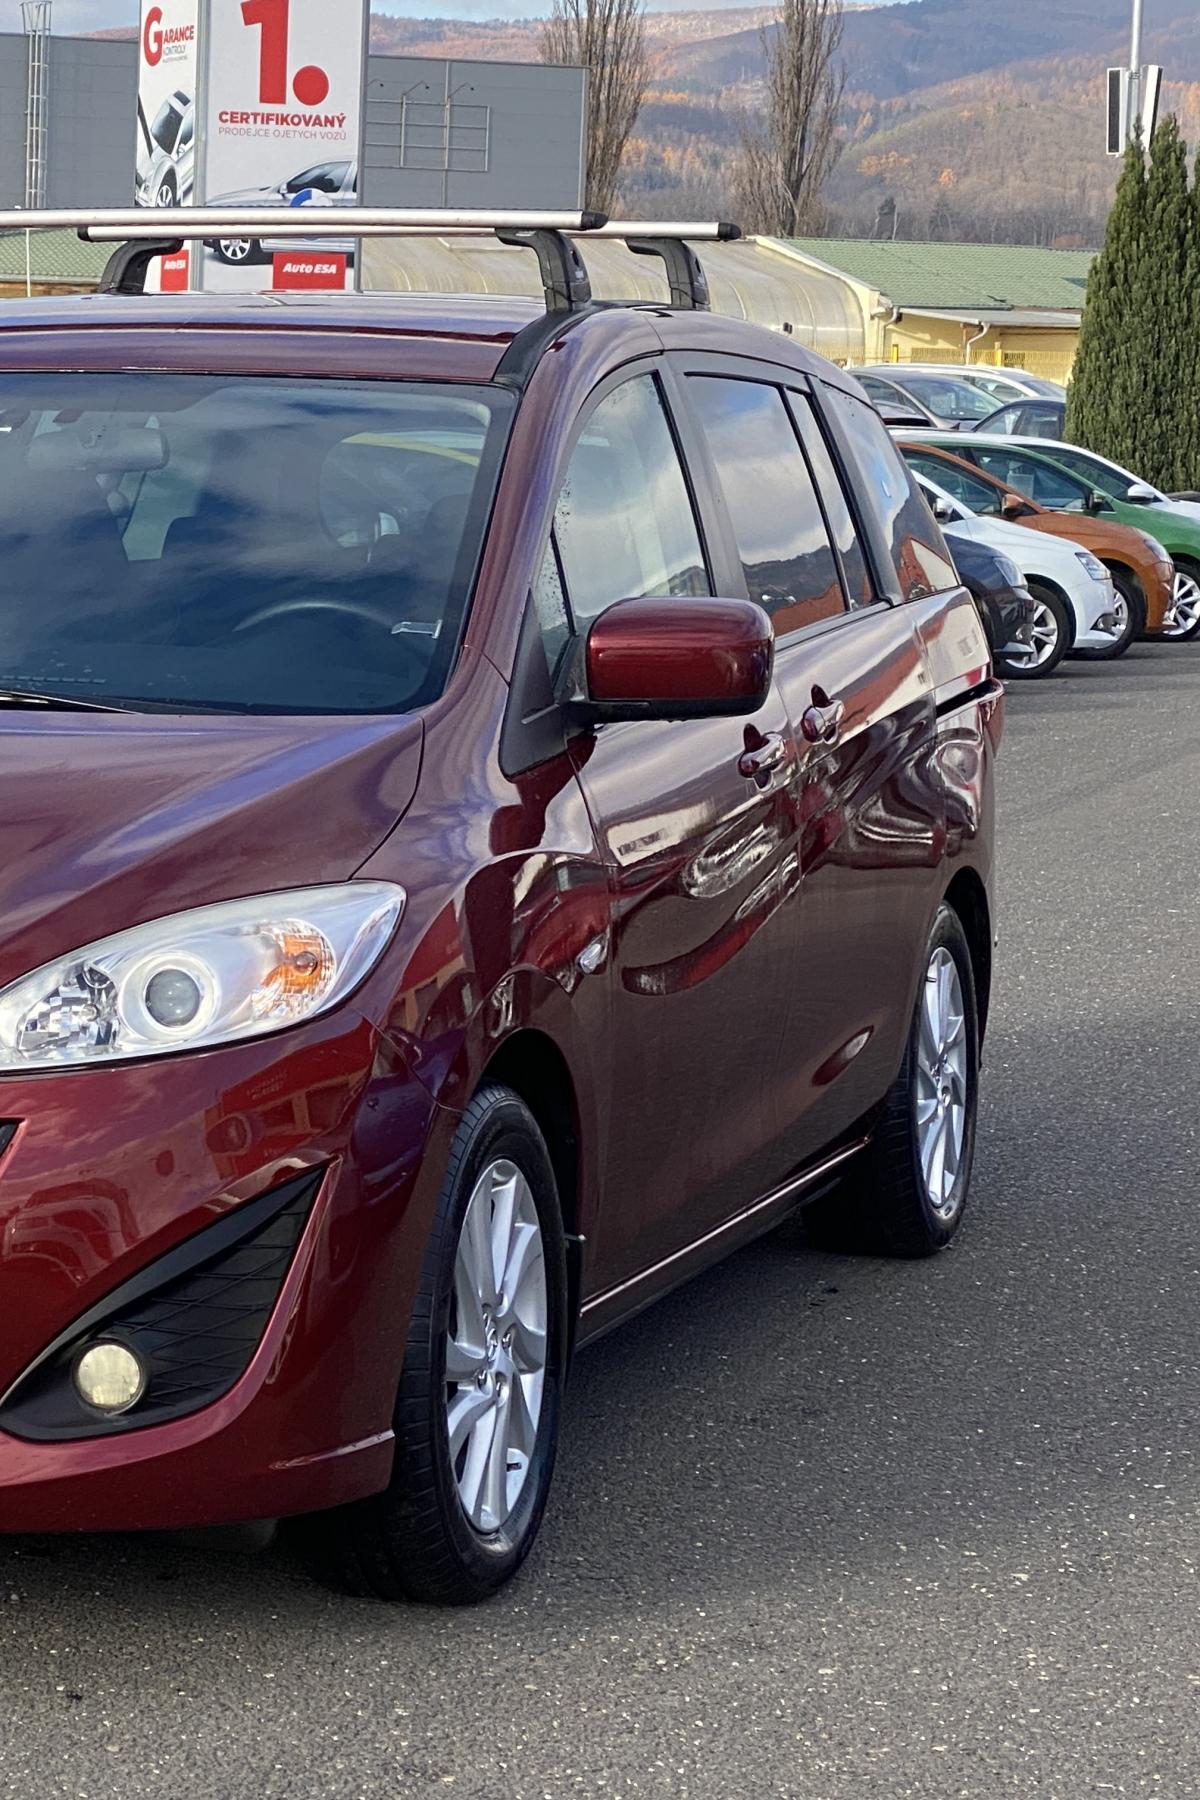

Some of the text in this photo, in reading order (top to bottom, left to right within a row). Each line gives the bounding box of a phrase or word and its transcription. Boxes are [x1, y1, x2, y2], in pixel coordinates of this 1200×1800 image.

[143, 6, 194, 66] GARANCE
[240, 0, 330, 106] 1.
[218, 111, 346, 128] CERTIFIKOVANÝ
[218, 127, 270, 137] PRODEJCE
[282, 262, 337, 274] Auto ESA
